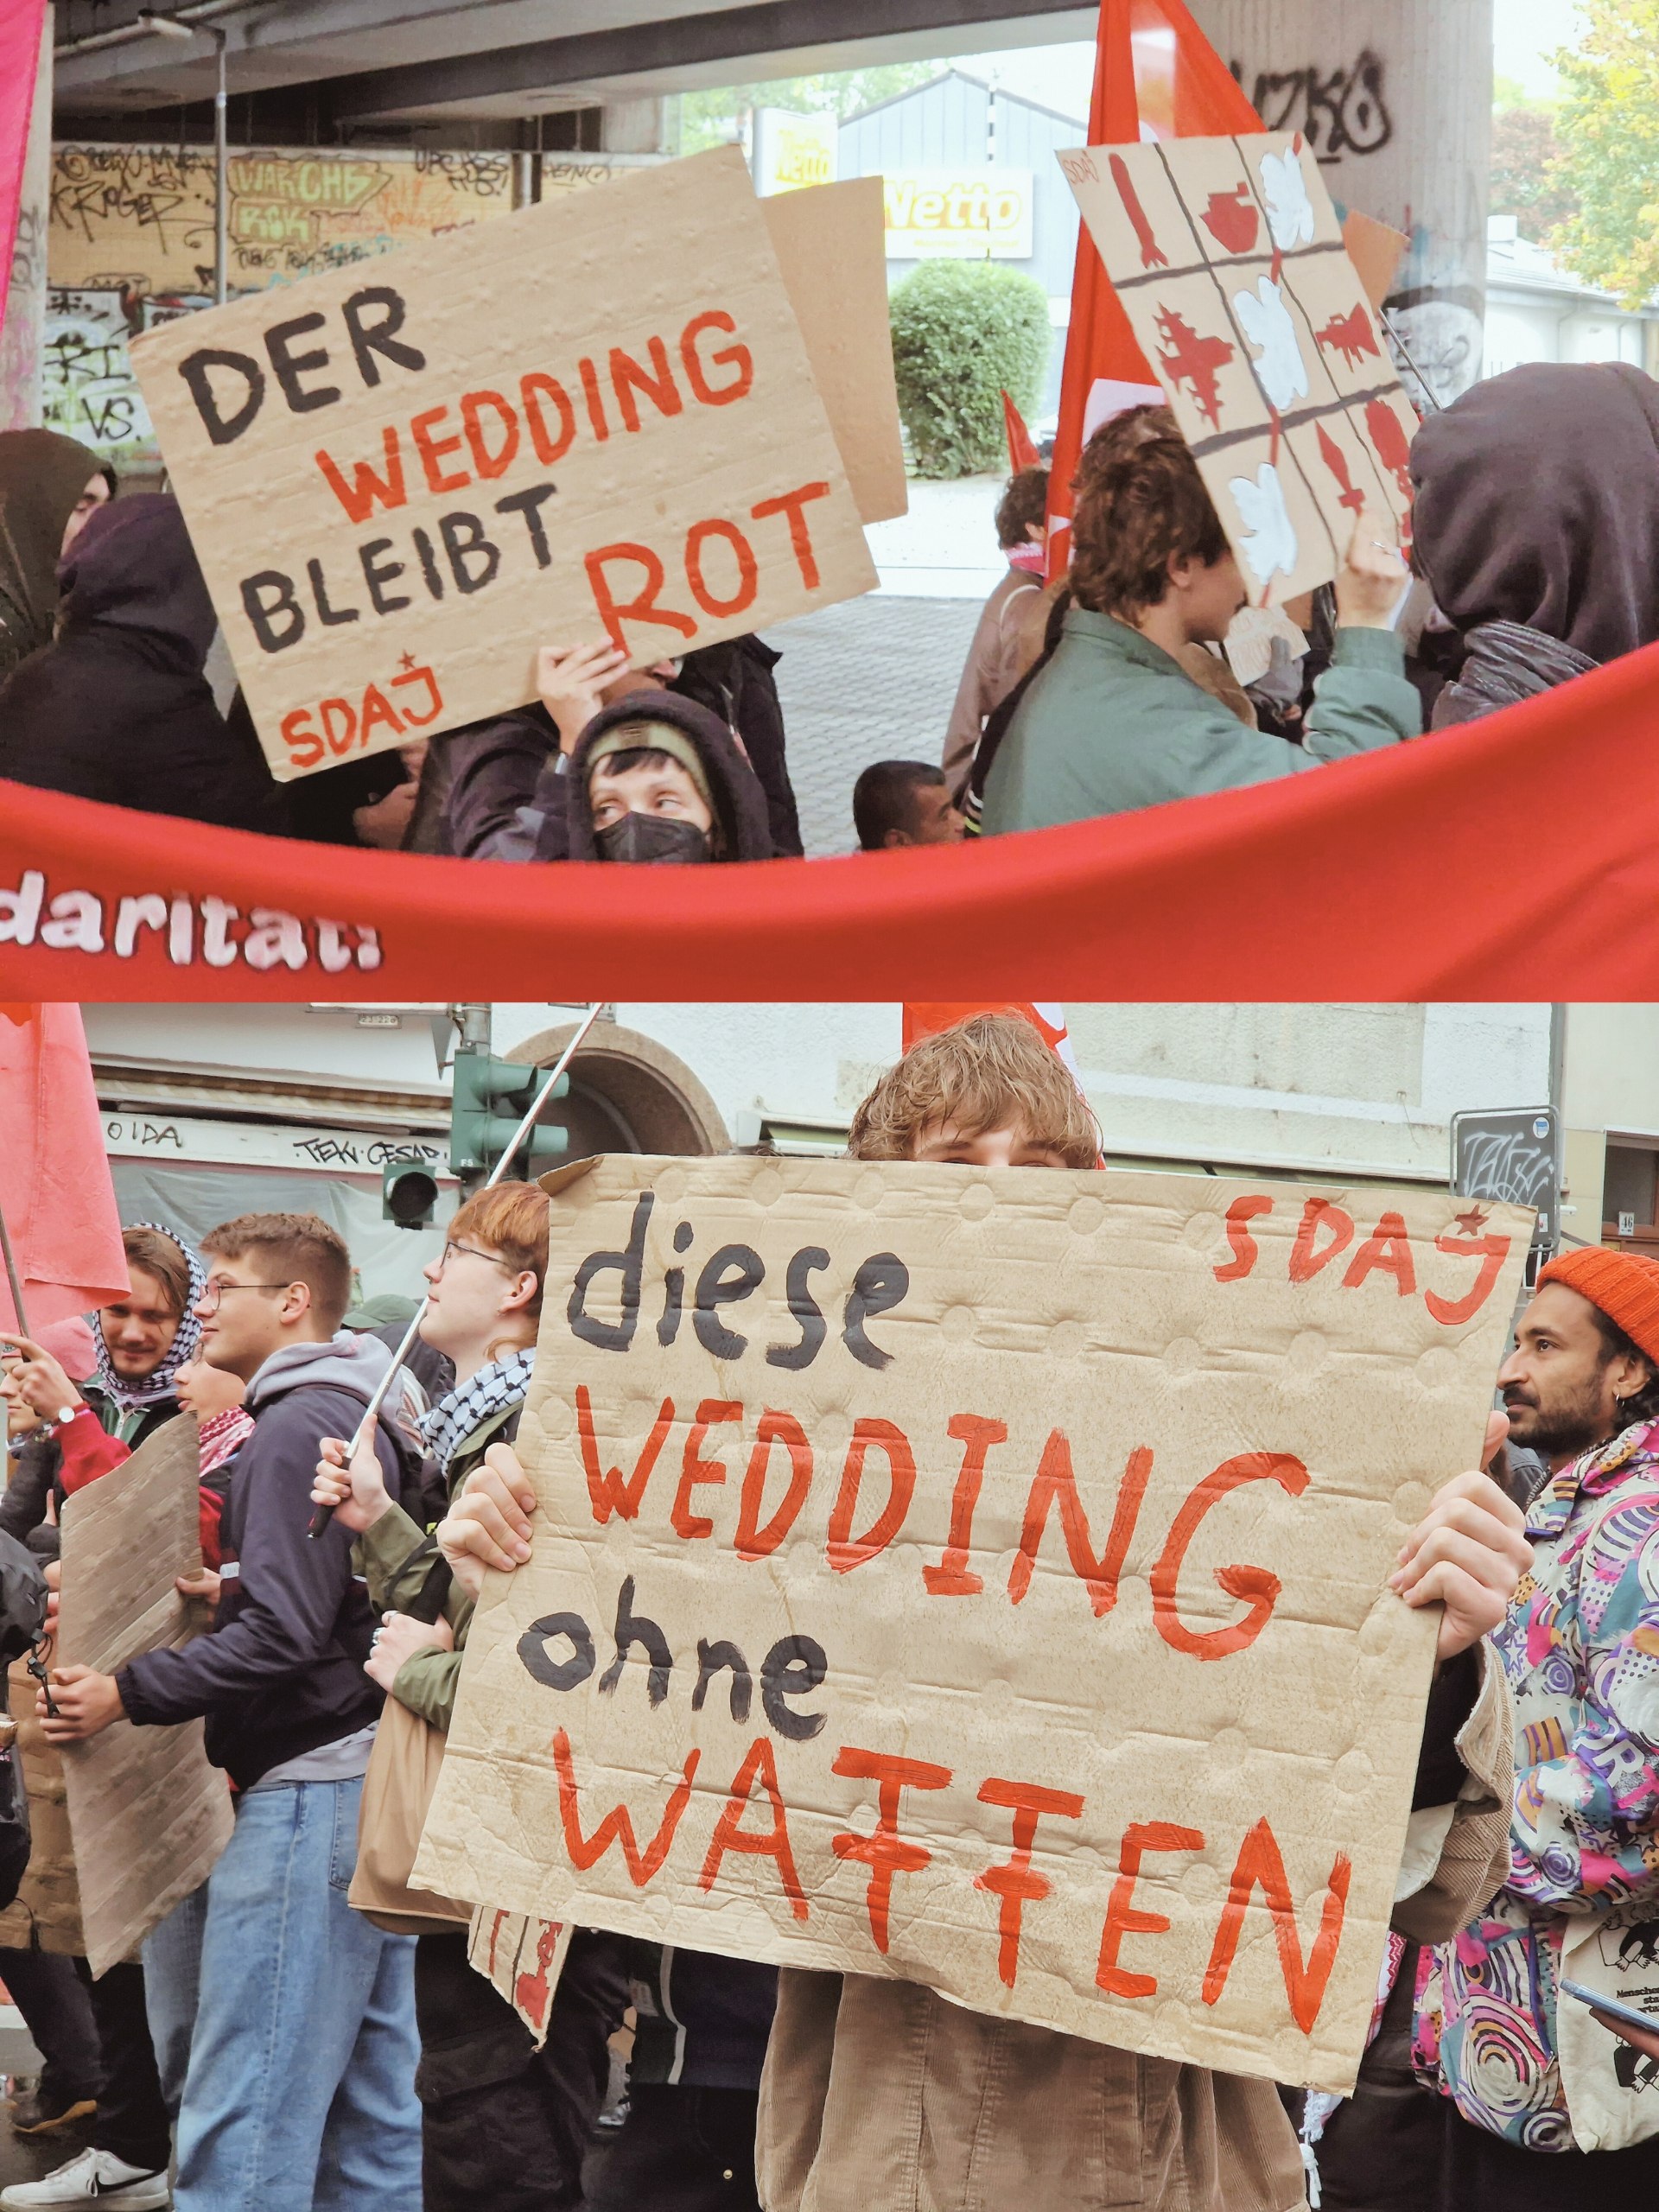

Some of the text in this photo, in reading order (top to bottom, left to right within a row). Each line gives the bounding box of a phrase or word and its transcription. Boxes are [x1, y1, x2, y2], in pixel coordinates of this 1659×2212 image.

[775, 129, 831, 183] Netto
[883, 180, 1020, 230] Netto
[178, 288, 425, 445] DER
[315, 310, 753, 524] WEDDING
[240, 481, 830, 658] BLEIBT ROT
[281, 664, 444, 768] SDAJ
[568, 1191, 912, 1370] diese
[1214, 1195, 1512, 1326] SDAJ
[575, 1384, 1311, 1662] WEDDING
[517, 1573, 828, 1741] ohne
